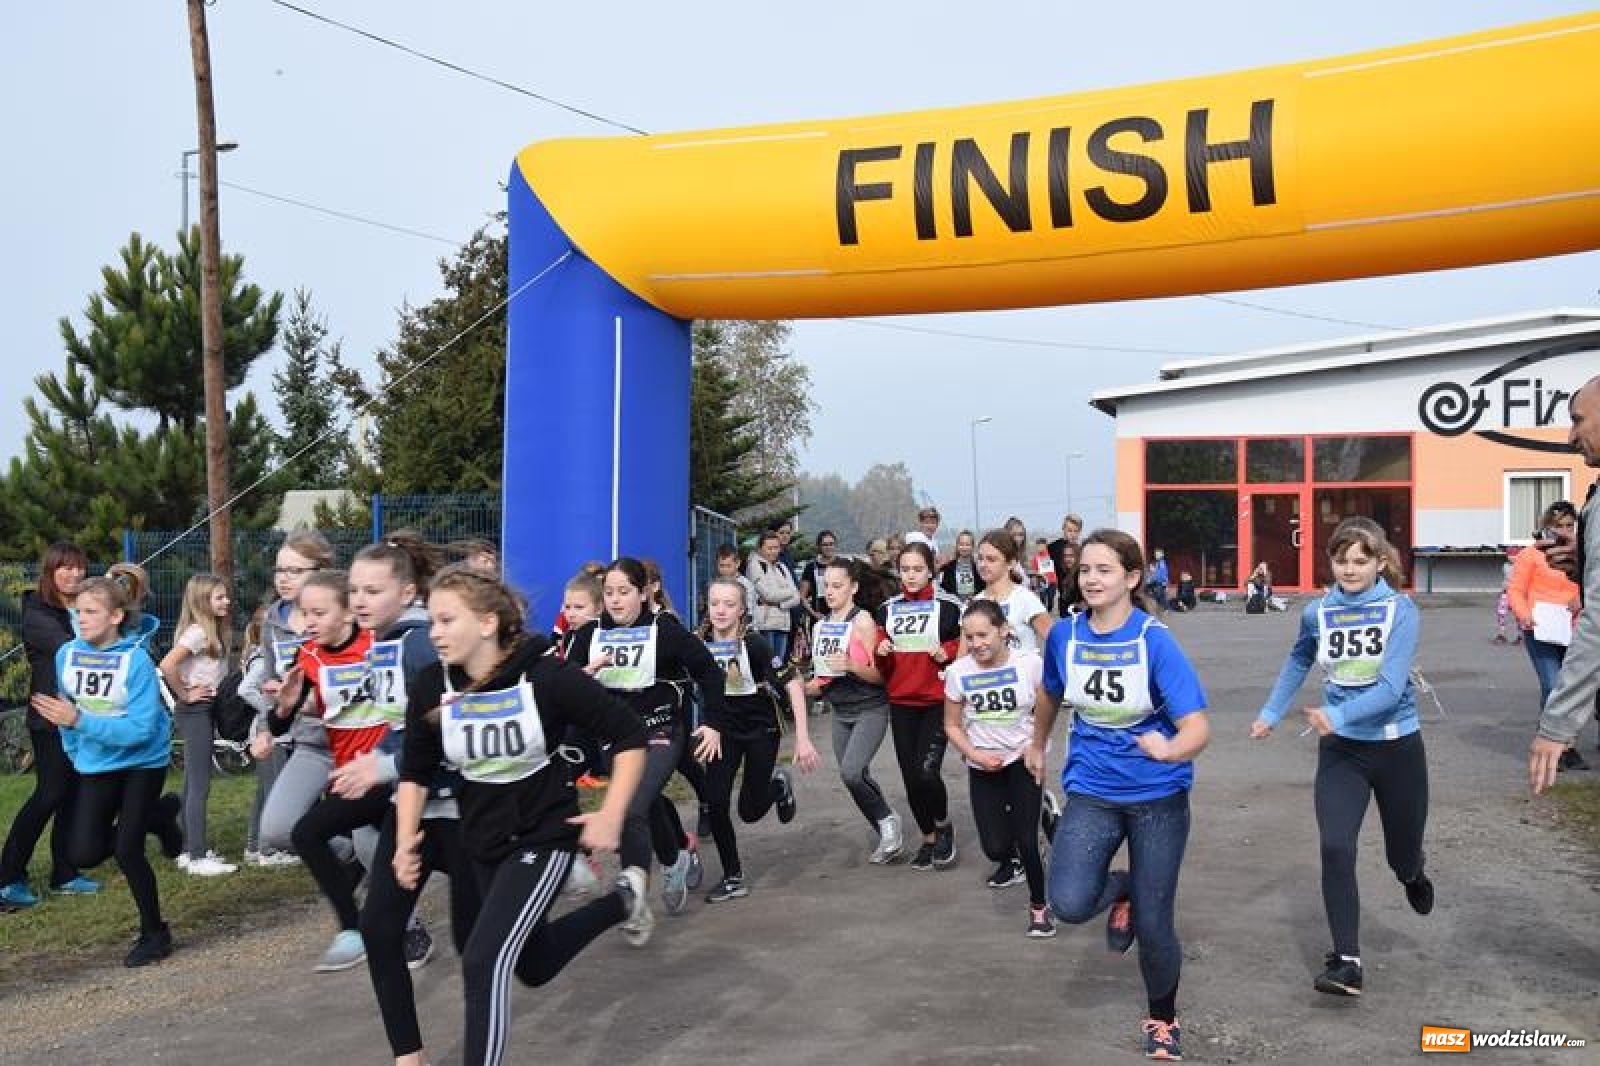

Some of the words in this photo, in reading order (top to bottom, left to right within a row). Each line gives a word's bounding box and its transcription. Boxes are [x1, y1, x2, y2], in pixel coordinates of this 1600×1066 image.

[836, 98, 1277, 245] FINISH
[1503, 377, 1580, 427] Fir
[893, 613, 930, 635] 227
[601, 644, 646, 667] 267
[1328, 626, 1383, 658] 953
[75, 670, 115, 697] 197
[1083, 669, 1125, 703] 45
[971, 687, 1017, 713] 289
[462, 720, 526, 761] 100
